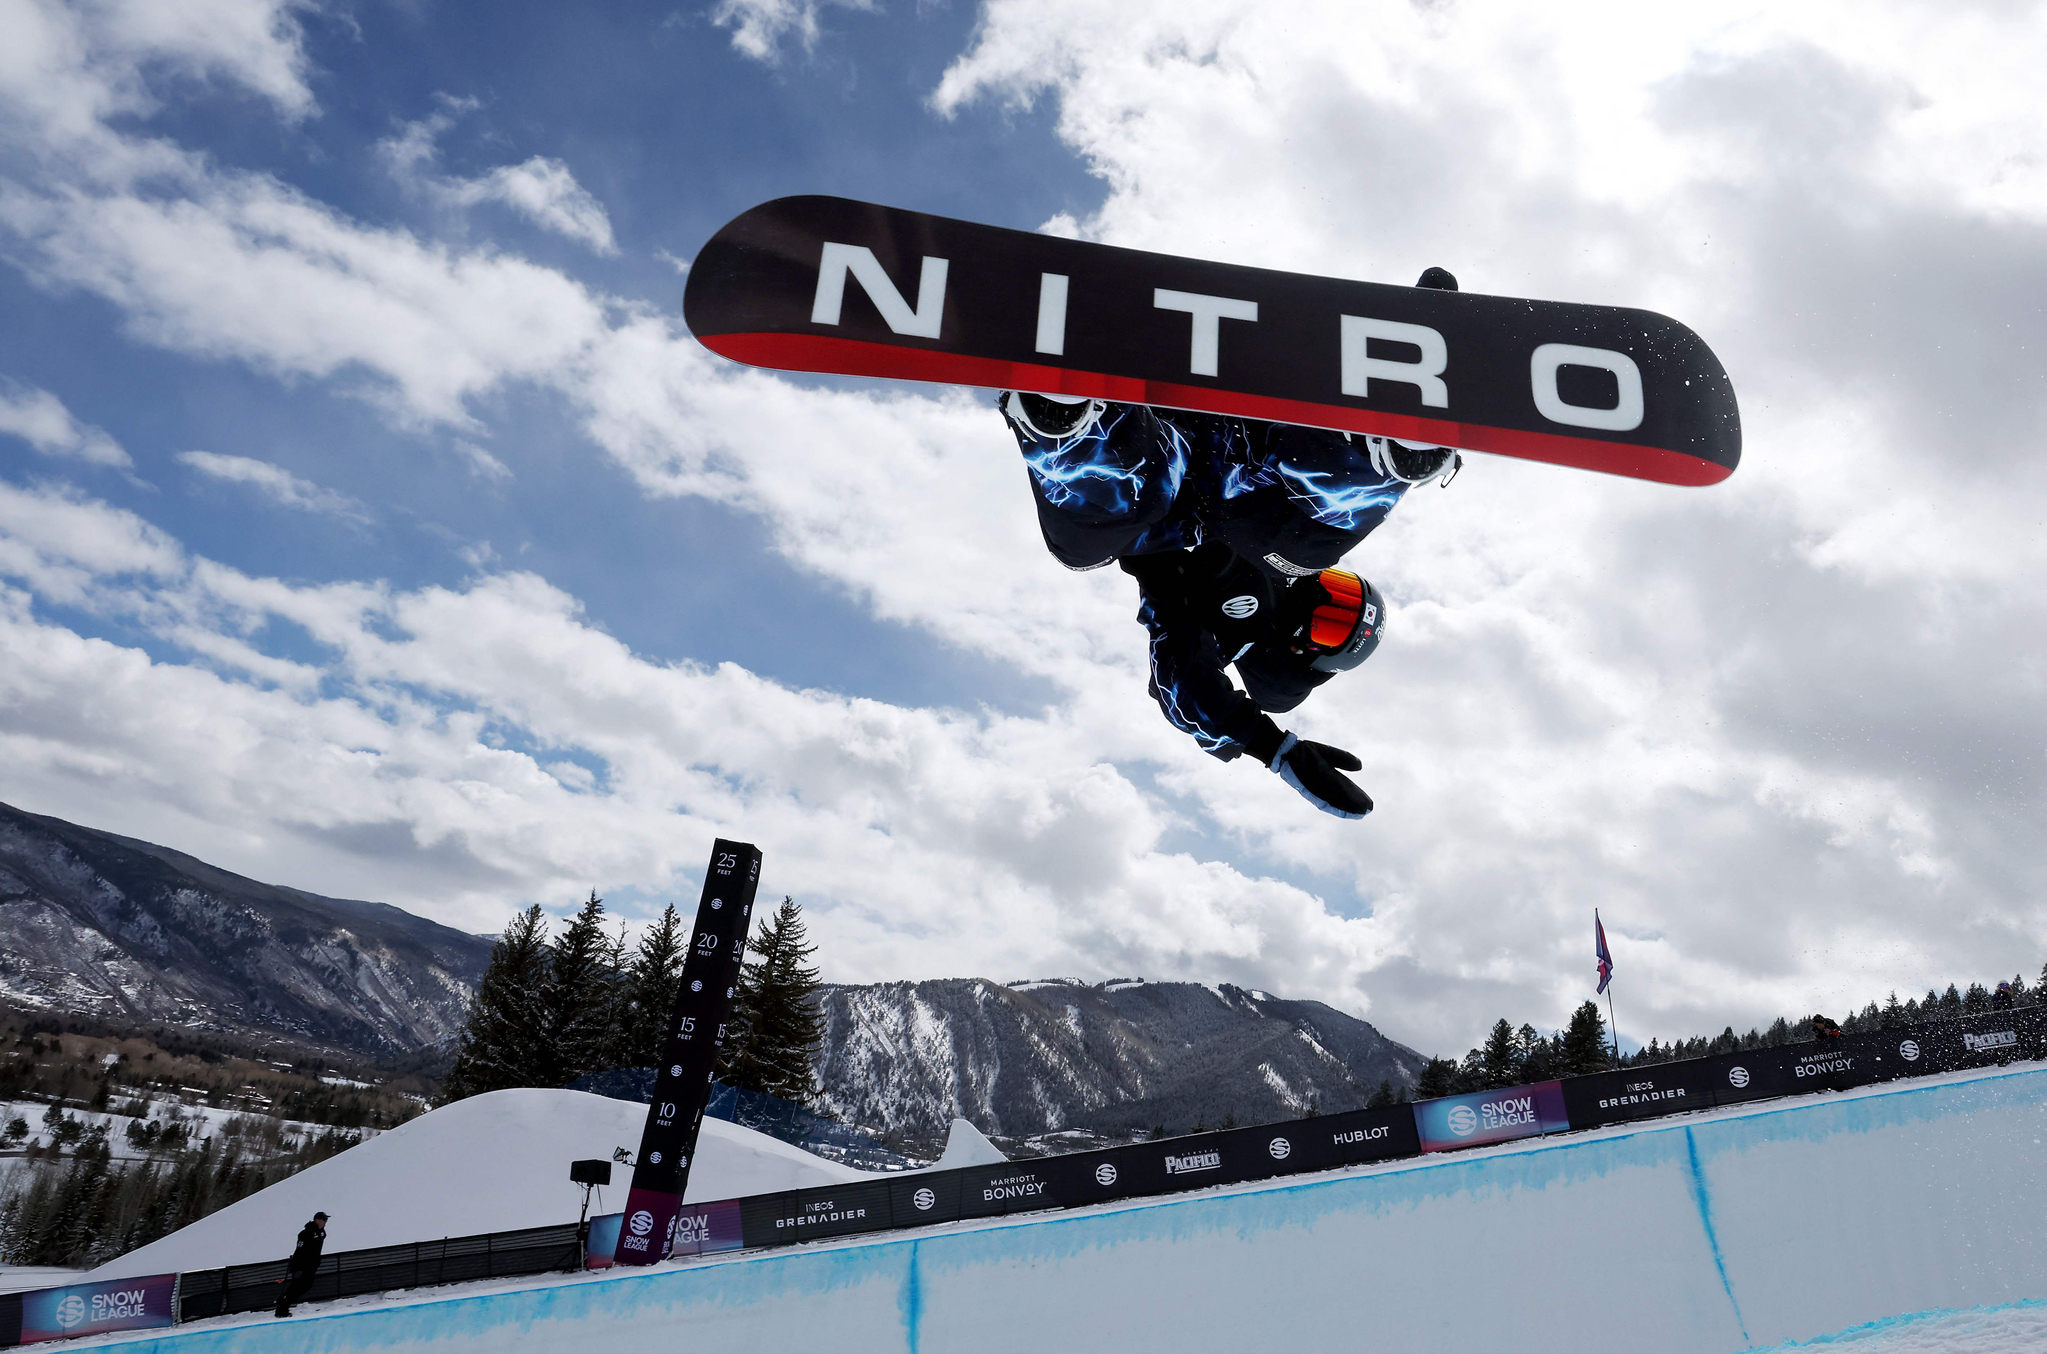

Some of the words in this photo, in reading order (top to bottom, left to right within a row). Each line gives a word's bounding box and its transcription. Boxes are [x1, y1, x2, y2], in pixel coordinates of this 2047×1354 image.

[811, 242, 1644, 432] NITRO
[717, 852, 737, 868] 25
[717, 868, 732, 876] FEET
[697, 932, 718, 949] 20
[733, 940, 744, 955] 20
[680, 1016, 697, 1033] 15
[717, 1023, 727, 1039] 15
[677, 1033, 693, 1041] FEET
[1800, 1051, 1843, 1064] MARRIOTT
[1794, 1058, 1852, 1078] BONVOY
[1626, 1081, 1654, 1093] INEOS
[1480, 1096, 1531, 1118] SNOW
[1598, 1088, 1686, 1109] GRENADIER
[659, 1102, 676, 1118] 10
[656, 1119, 672, 1127] FEET
[1483, 1110, 1536, 1130] LEAGUE
[1333, 1126, 1389, 1145] HUBLOT
[1164, 1152, 1220, 1174] PACIFICO
[990, 1174, 1036, 1187] MARRIOTT
[983, 1182, 1044, 1201] BONVOY
[805, 1201, 834, 1213] INEOS
[675, 1214, 708, 1232] OW
[776, 1208, 866, 1228] GRENADIER
[625, 1235, 650, 1246] SNOW
[673, 1228, 710, 1245] AGUE
[623, 1241, 648, 1252] LEAGUE
[91, 1289, 145, 1309] SNOW
[90, 1303, 145, 1322] LEAGUE
